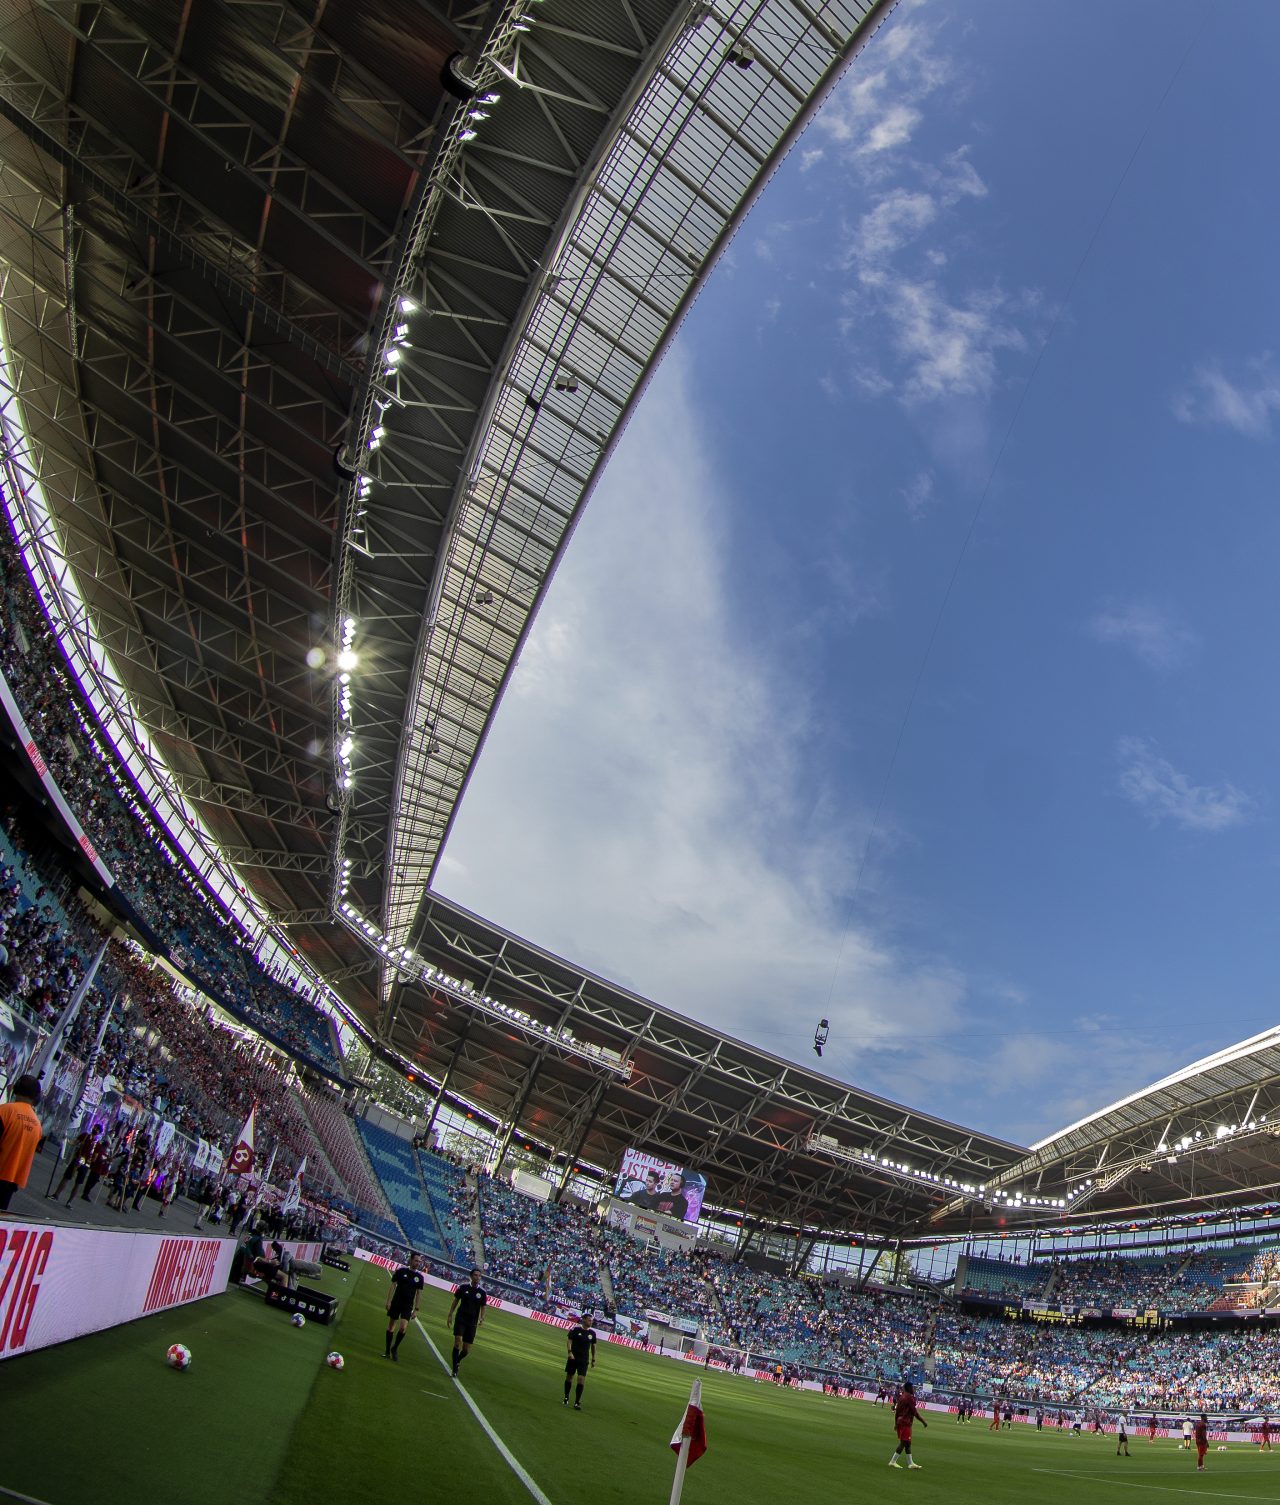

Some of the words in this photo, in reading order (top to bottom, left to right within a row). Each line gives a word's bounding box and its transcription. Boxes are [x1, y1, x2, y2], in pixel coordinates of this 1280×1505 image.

[143, 1239, 193, 1312] IMMER
[181, 1241, 221, 1301] LEIPZIG
[530, 1310, 554, 1325] IMMER
[608, 1334, 631, 1348] IMMER
